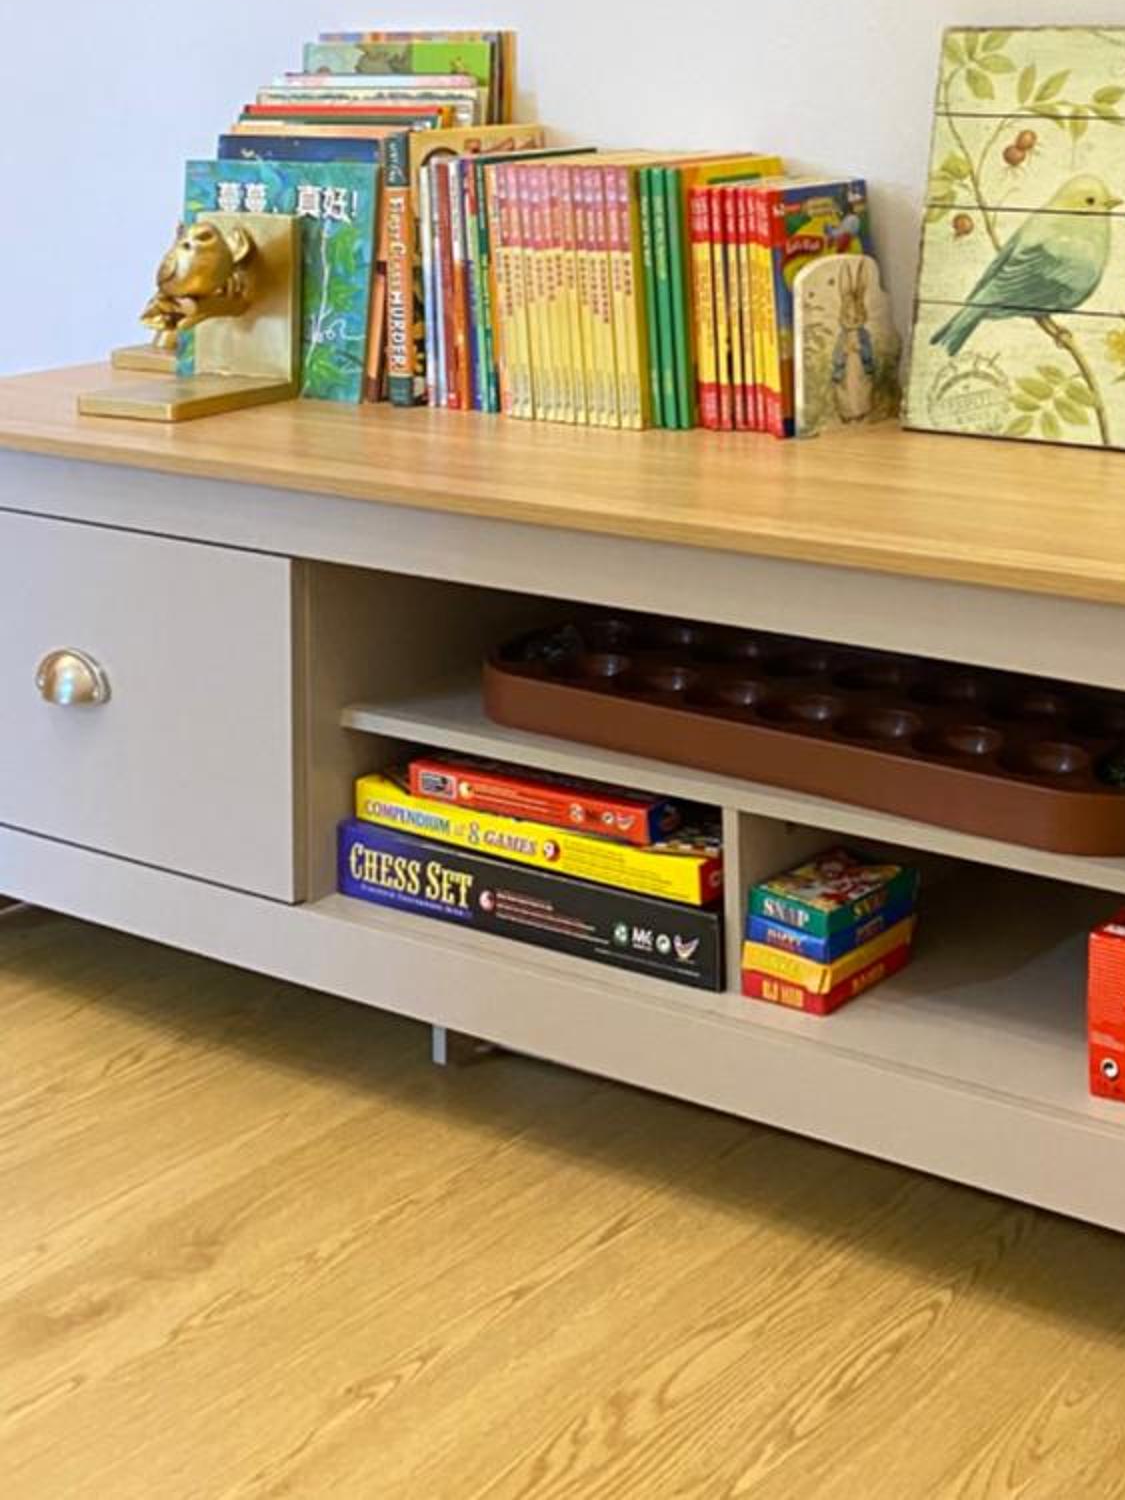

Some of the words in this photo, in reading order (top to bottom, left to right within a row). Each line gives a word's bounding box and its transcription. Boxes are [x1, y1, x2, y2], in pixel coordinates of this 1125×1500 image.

[367, 800, 450, 836] COMPENDIUM
[468, 821, 480, 846] 8
[483, 830, 537, 856] GAMES
[350, 842, 421, 896] CHESS
[425, 861, 473, 909] SET
